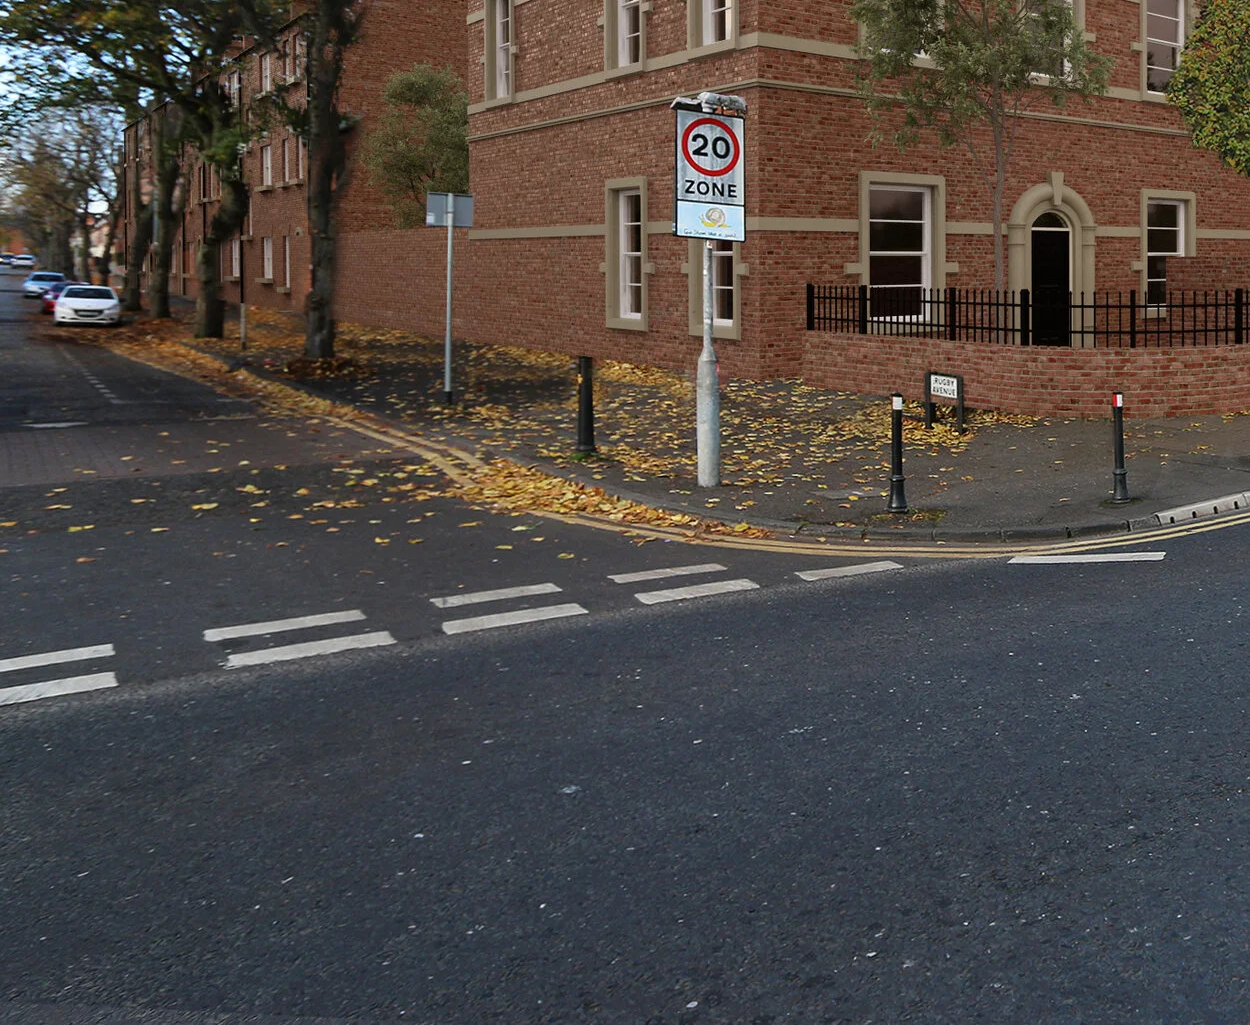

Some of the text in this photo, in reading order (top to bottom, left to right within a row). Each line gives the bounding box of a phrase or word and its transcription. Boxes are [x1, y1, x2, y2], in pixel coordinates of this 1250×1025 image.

[692, 134, 731, 159] 20
[685, 180, 737, 198] ZONE
[933, 377, 954, 386] RUGBY
[932, 386, 955, 396] AVENUE
